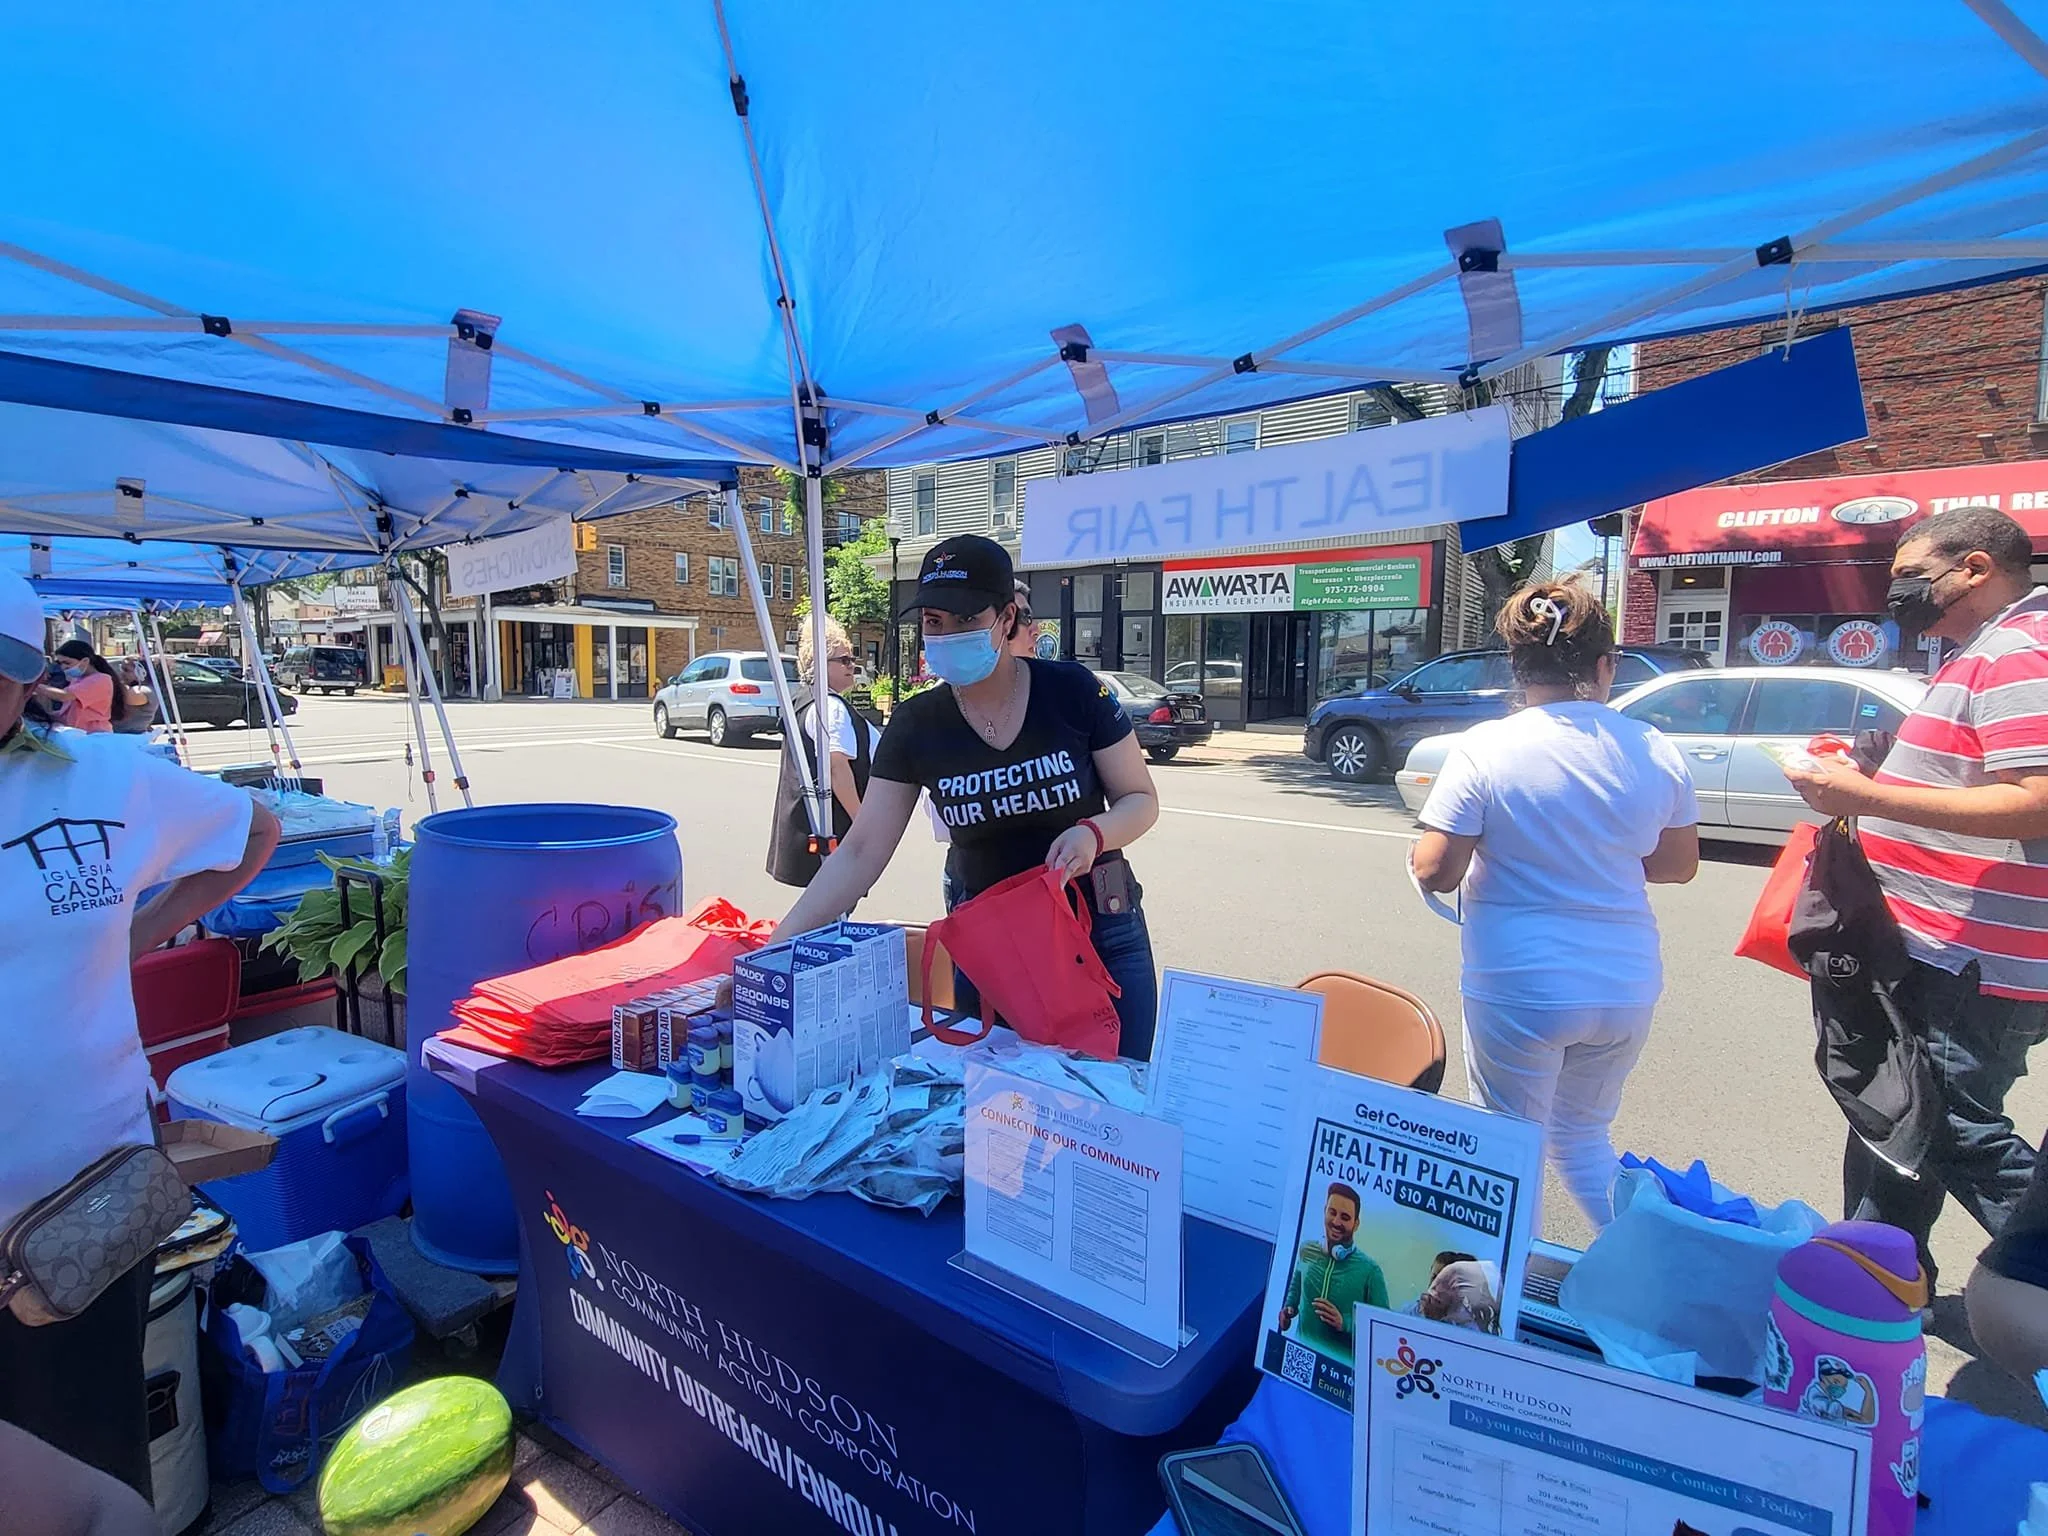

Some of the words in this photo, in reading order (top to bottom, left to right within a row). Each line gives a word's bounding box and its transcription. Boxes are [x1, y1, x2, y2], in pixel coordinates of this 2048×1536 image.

[1717, 506, 1820, 528] CLIFTON
[1164, 598, 1220, 608] INSURANCE
[1226, 596, 1266, 606] AGENCY
[1273, 596, 1291, 604] INC
[1301, 597, 1320, 606] Right
[1347, 596, 1369, 604] Right
[1325, 584, 1385, 594] 973-772-0904
[1837, 623, 1881, 636] CLIFTON
[938, 750, 1075, 797] PROTECTING
[943, 802, 986, 827] OUR
[992, 779, 1081, 818] HEALTH
[42, 864, 113, 883] IGLESIA
[45, 876, 116, 903] CASA
[51, 894, 124, 916] ESPERANZA
[843, 925, 879, 936] MOLDEX
[795, 945, 830, 961] MOLDEX
[735, 965, 765, 983] MOLDEX
[735, 984, 790, 1010] 2200N95
[614, 1009, 622, 1061] BAND-AID
[660, 1011, 670, 1063] BAND-AID
[1060, 1108, 1098, 1132] HUDSON
[981, 1106, 1049, 1140] CONNECTING
[1052, 1133, 1077, 1151] OUR
[1081, 1143, 1160, 1182] COMMUNITY
[1320, 1127, 1408, 1176] HEALTH
[1416, 1159, 1505, 1207] PLANS
[1316, 1157, 1334, 1176] AS
[1338, 1163, 1369, 1186] LOW
[1373, 1175, 1393, 1196] AS
[1399, 1185, 1421, 1205] $10
[1426, 1195, 1437, 1211] A
[1442, 1200, 1497, 1231] MONTH
[569, 1288, 670, 1391] COMMUNITY
[598, 1241, 709, 1336] NORTH
[715, 1320, 898, 1458] HUDSON
[1320, 1363, 1327, 1374] 9
[1329, 1367, 1340, 1379] in
[1318, 1378, 1345, 1400] Enroll
[1441, 1372, 1495, 1395] NORTH
[1502, 1387, 1572, 1417] HUDSON
[611, 1279, 710, 1360] COMMUNITY
[718, 1352, 793, 1419] ACTION
[798, 1408, 976, 1535] CORPORATION
[1441, 1386, 1484, 1403] COMMUNITY
[1487, 1400, 1515, 1412] ACTION
[1518, 1408, 1572, 1428] CORPORATION
[1464, 1408, 1483, 1424] Do
[1486, 1418, 1511, 1434] you
[1514, 1424, 1545, 1442] need
[1548, 1432, 1589, 1455] health
[1592, 1447, 1667, 1478] insurance?
[1671, 1470, 1728, 1497] Contact
[1732, 1487, 1753, 1504] Us
[1759, 1495, 1813, 1523] Today!
